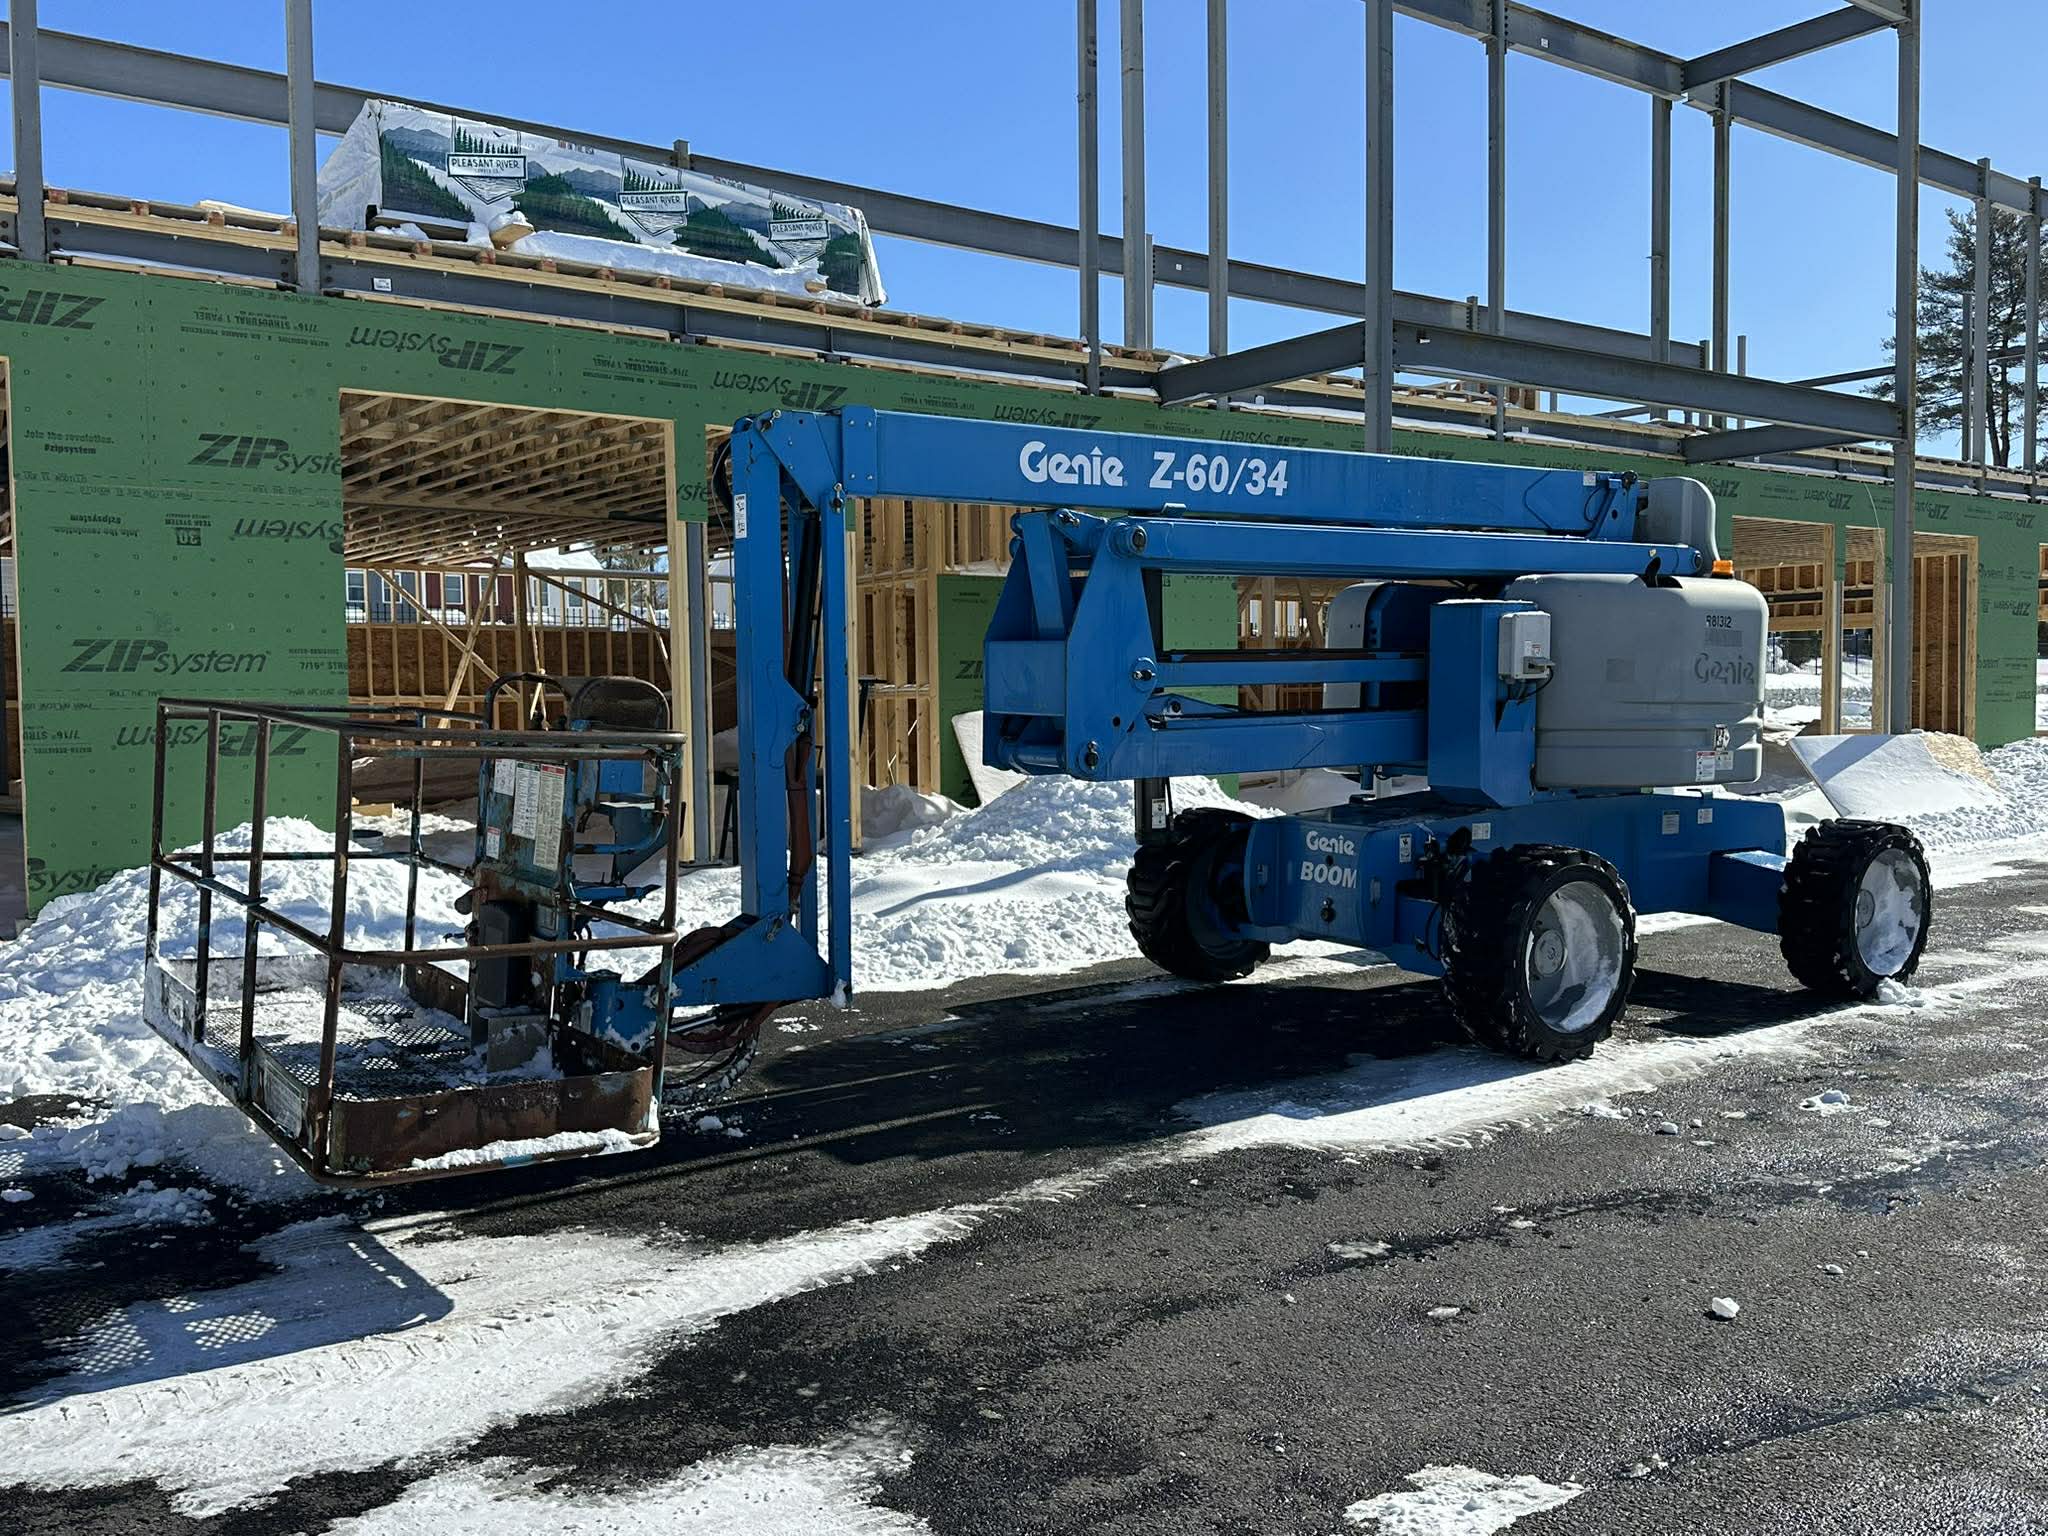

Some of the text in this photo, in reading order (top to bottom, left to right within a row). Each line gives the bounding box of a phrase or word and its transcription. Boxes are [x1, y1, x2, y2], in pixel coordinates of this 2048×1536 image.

[451, 158, 520, 171] PLEASANT RIVER
[622, 196, 680, 206] PLEASANT RIVER
[772, 224, 804, 232] PLEASANT
[346, 326, 525, 376] ZIPsystem
[1019, 440, 1288, 496] Genie Z-60/34
[60, 638, 270, 676] ZIPsystem
[1695, 652, 1755, 685] Genie
[1306, 830, 1356, 856] Genie
[1300, 861, 1358, 889] BOOM
